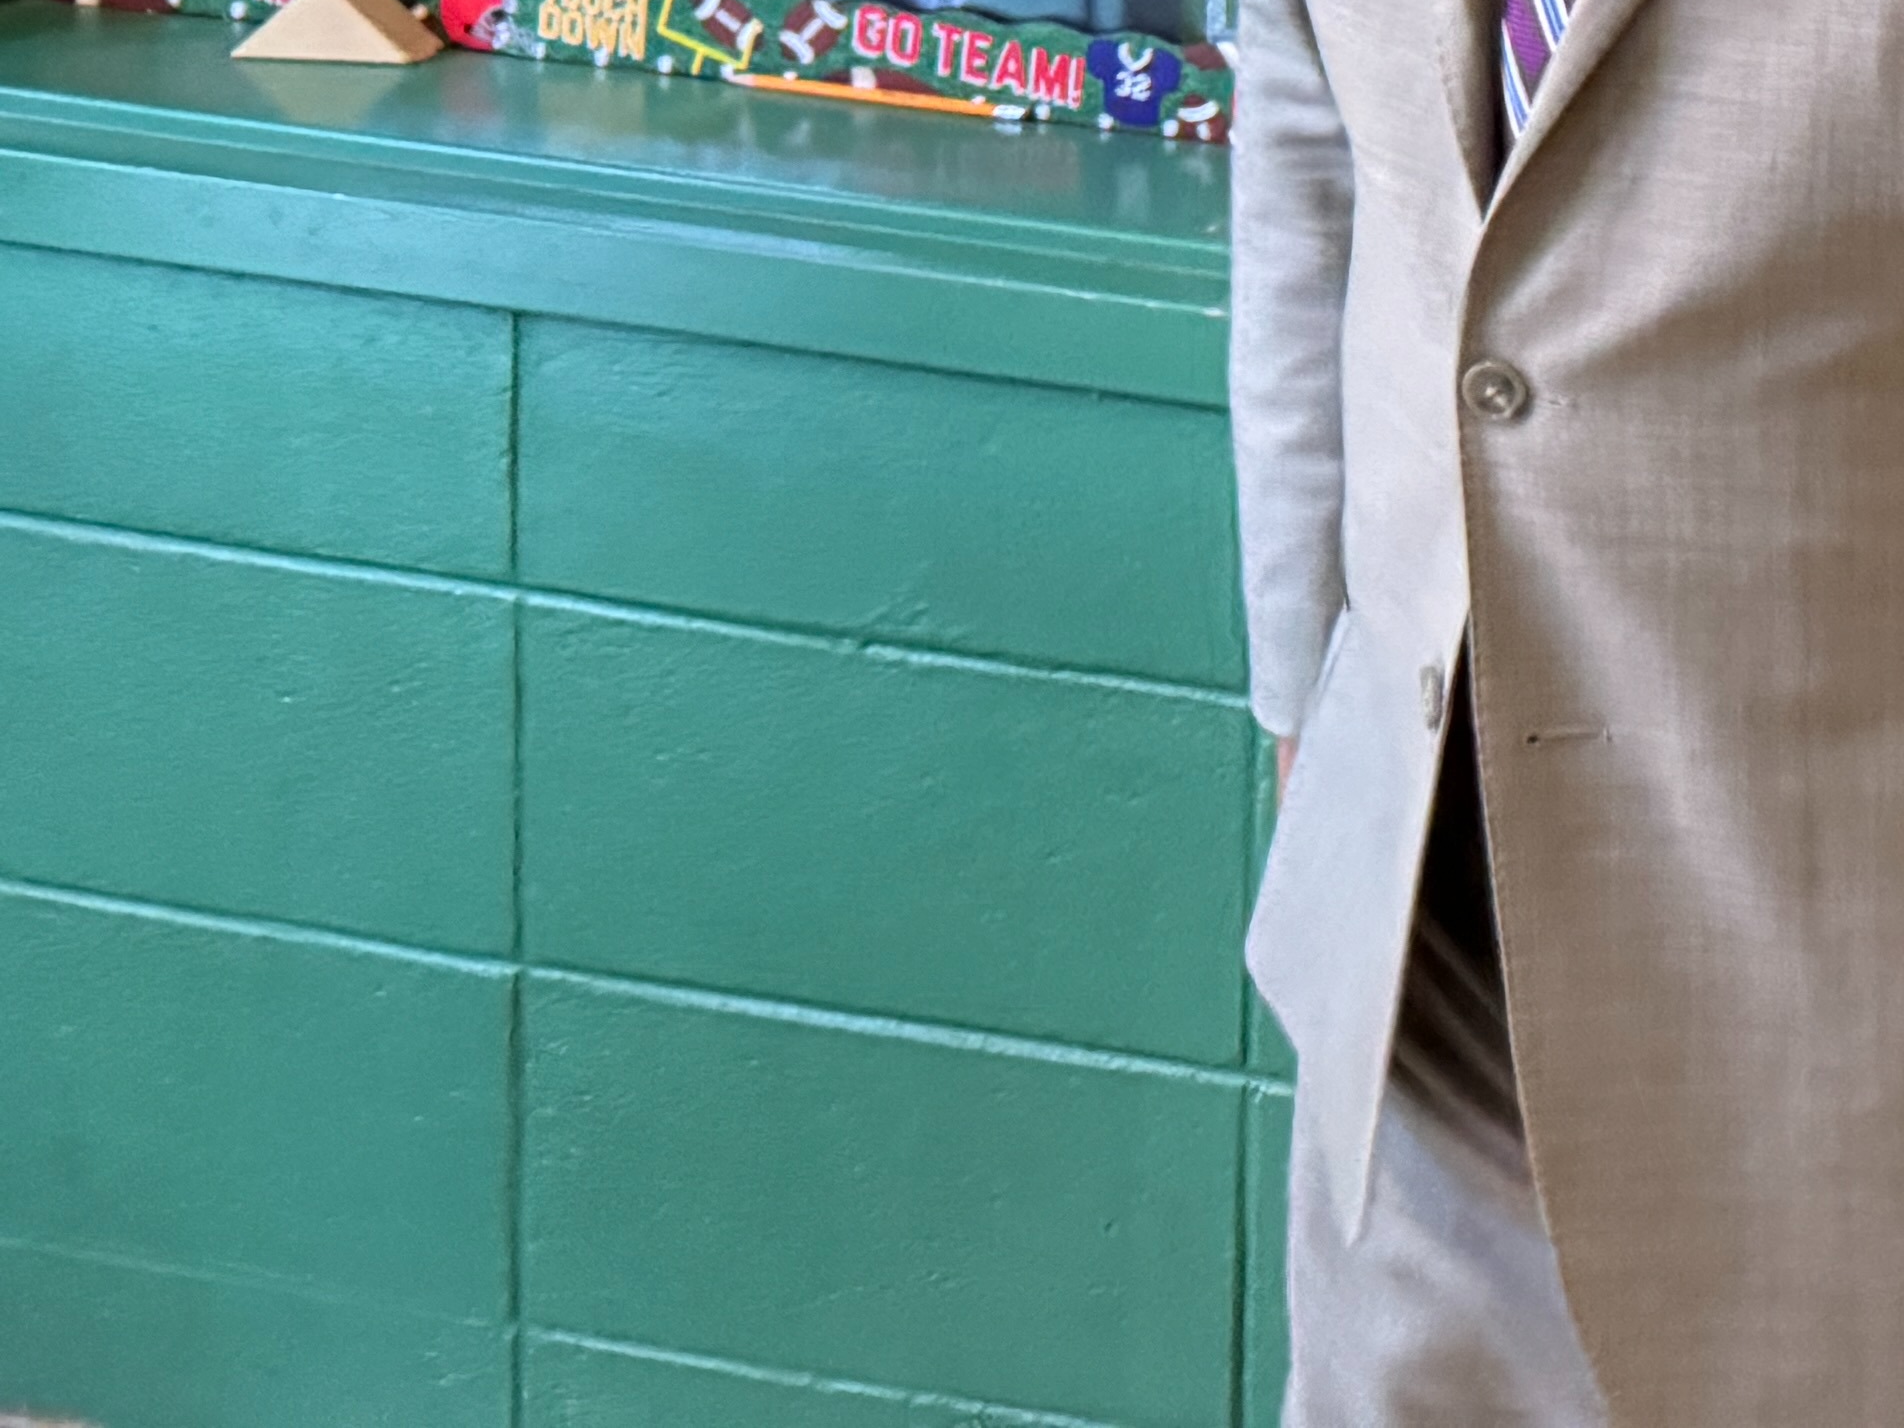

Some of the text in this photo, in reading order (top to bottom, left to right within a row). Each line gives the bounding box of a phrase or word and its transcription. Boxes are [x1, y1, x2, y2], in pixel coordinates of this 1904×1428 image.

[538, 5, 645, 61] DOWN
[852, 5, 1085, 109] GO TEAM!
[1115, 71, 1151, 103] 32
